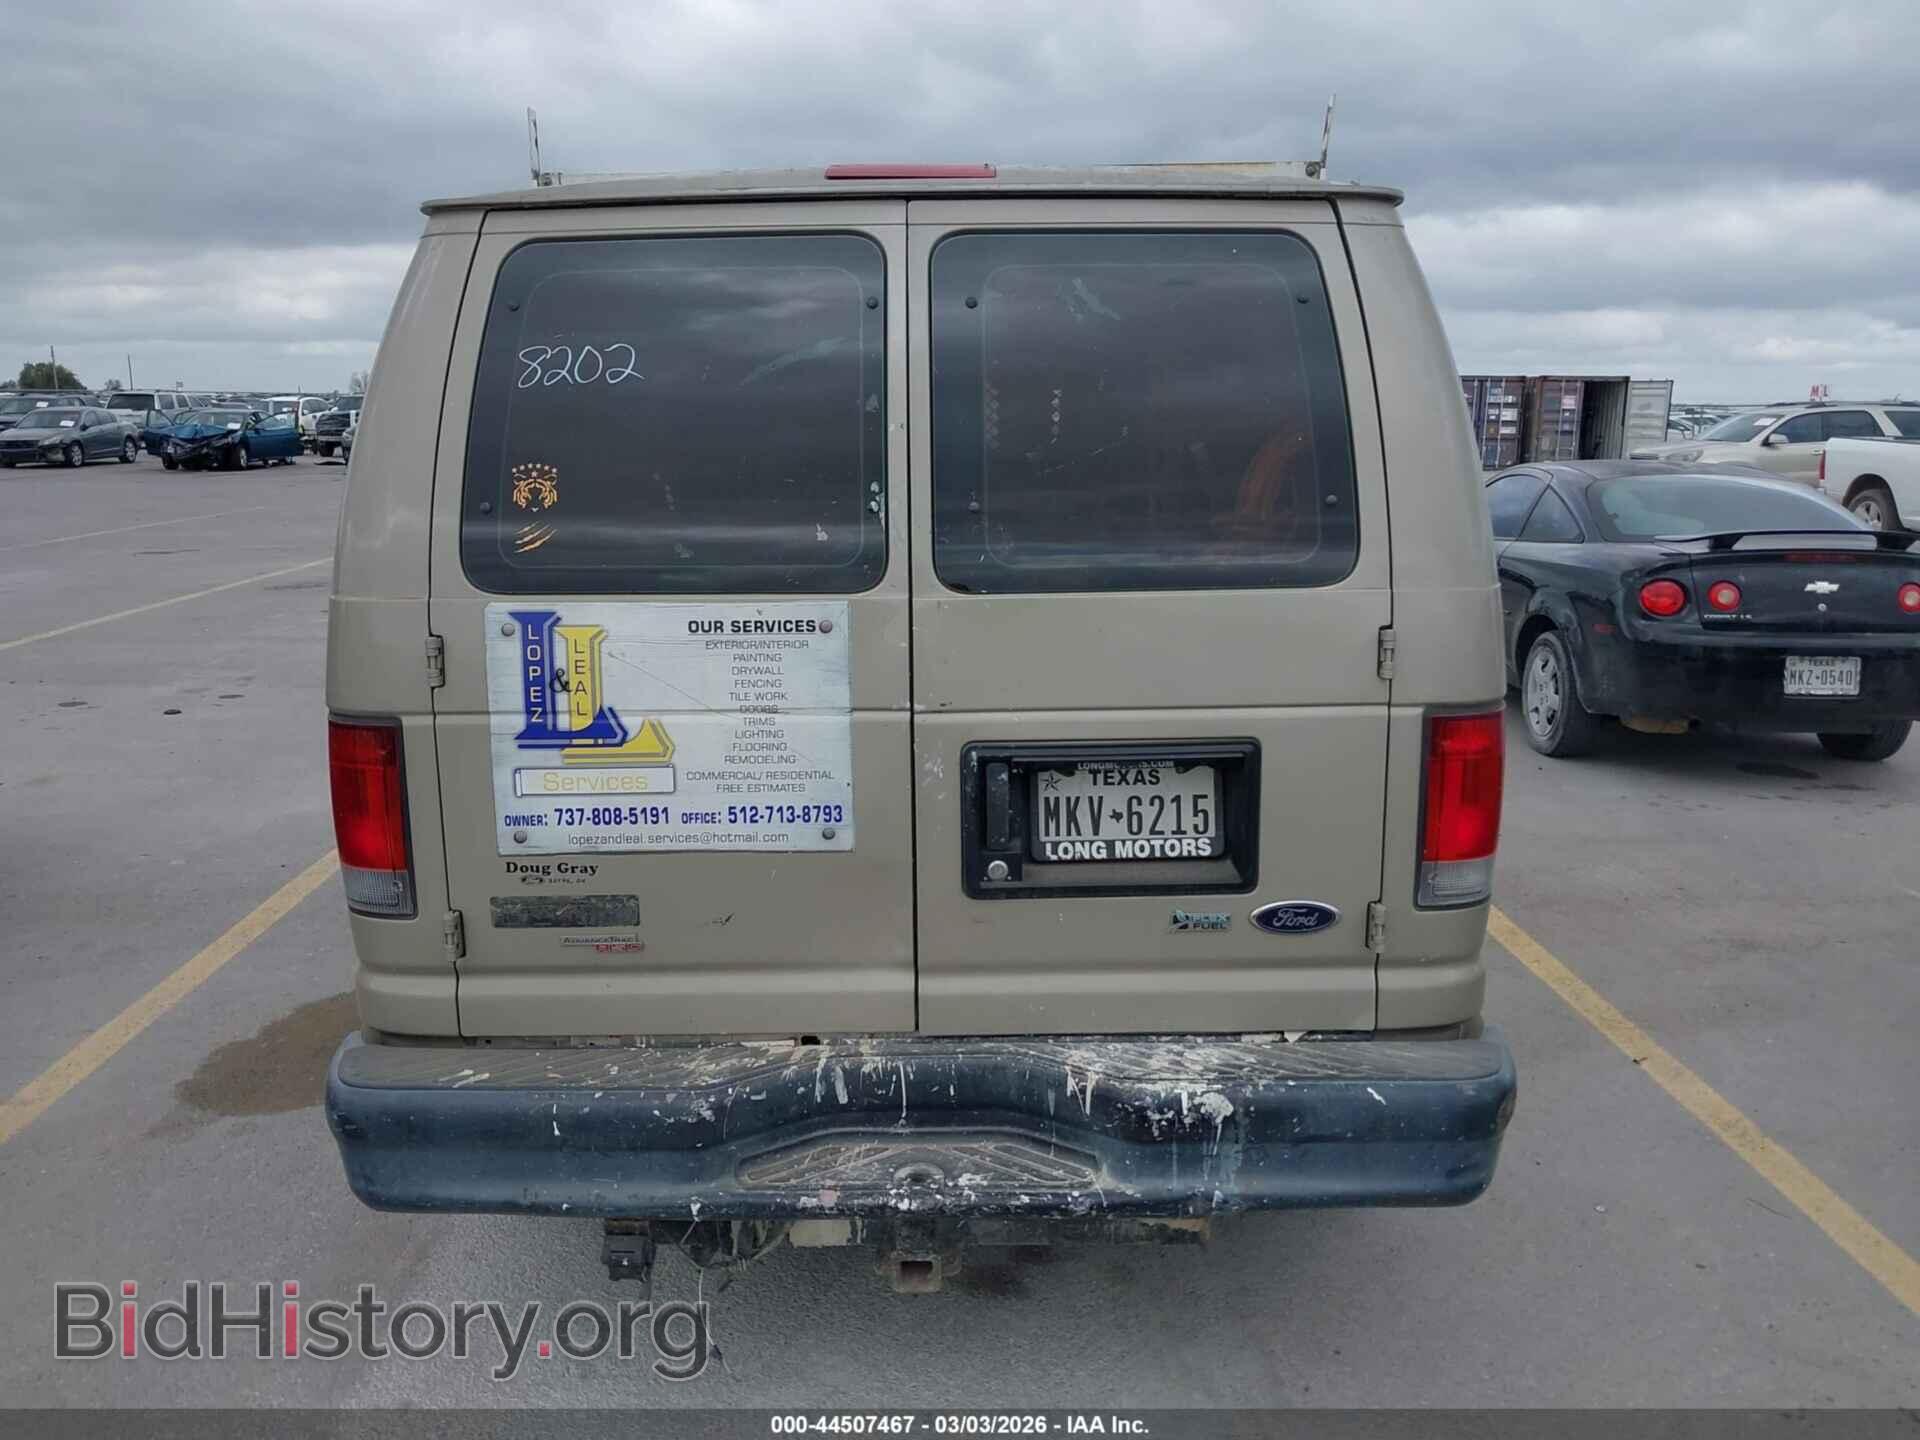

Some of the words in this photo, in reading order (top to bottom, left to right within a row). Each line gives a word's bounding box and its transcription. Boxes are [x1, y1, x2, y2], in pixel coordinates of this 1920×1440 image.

[518, 343, 646, 388] 8202
[688, 620, 725, 633] OUR
[731, 619, 817, 633] SERVICES
[705, 640, 809, 649] EXTERIOR/INTERIOR
[733, 653, 782, 662] PAINTING
[527, 623, 544, 723] LOPEZ
[574, 638, 588, 716] LEAL
[731, 666, 784, 675] DRYWALL
[734, 679, 782, 688] FENCING
[729, 692, 750, 701] TILE
[754, 692, 788, 701] WORK
[743, 717, 776, 726] TRIMS
[735, 730, 784, 739] LIGHTING
[732, 743, 787, 752] FLOORING
[724, 755, 796, 765] REMODELING
[765, 771, 834, 780] RESIDENTIAL
[1089, 769, 1160, 786] TEXAS
[543, 772, 648, 792] Services
[716, 784, 743, 793] FREE
[747, 783, 806, 793] ESTIMATES
[504, 814, 548, 827] OWNER:
[554, 807, 669, 826] 737-808-5191
[681, 811, 722, 825] OFFICE:
[727, 804, 843, 825] 512-713-8793
[1045, 842, 1107, 861] LONG
[1115, 838, 1212, 858] MOTORS
[505, 861, 551, 876] Doug
[557, 862, 599, 876] Gray
[1272, 907, 1319, 927] Ford
